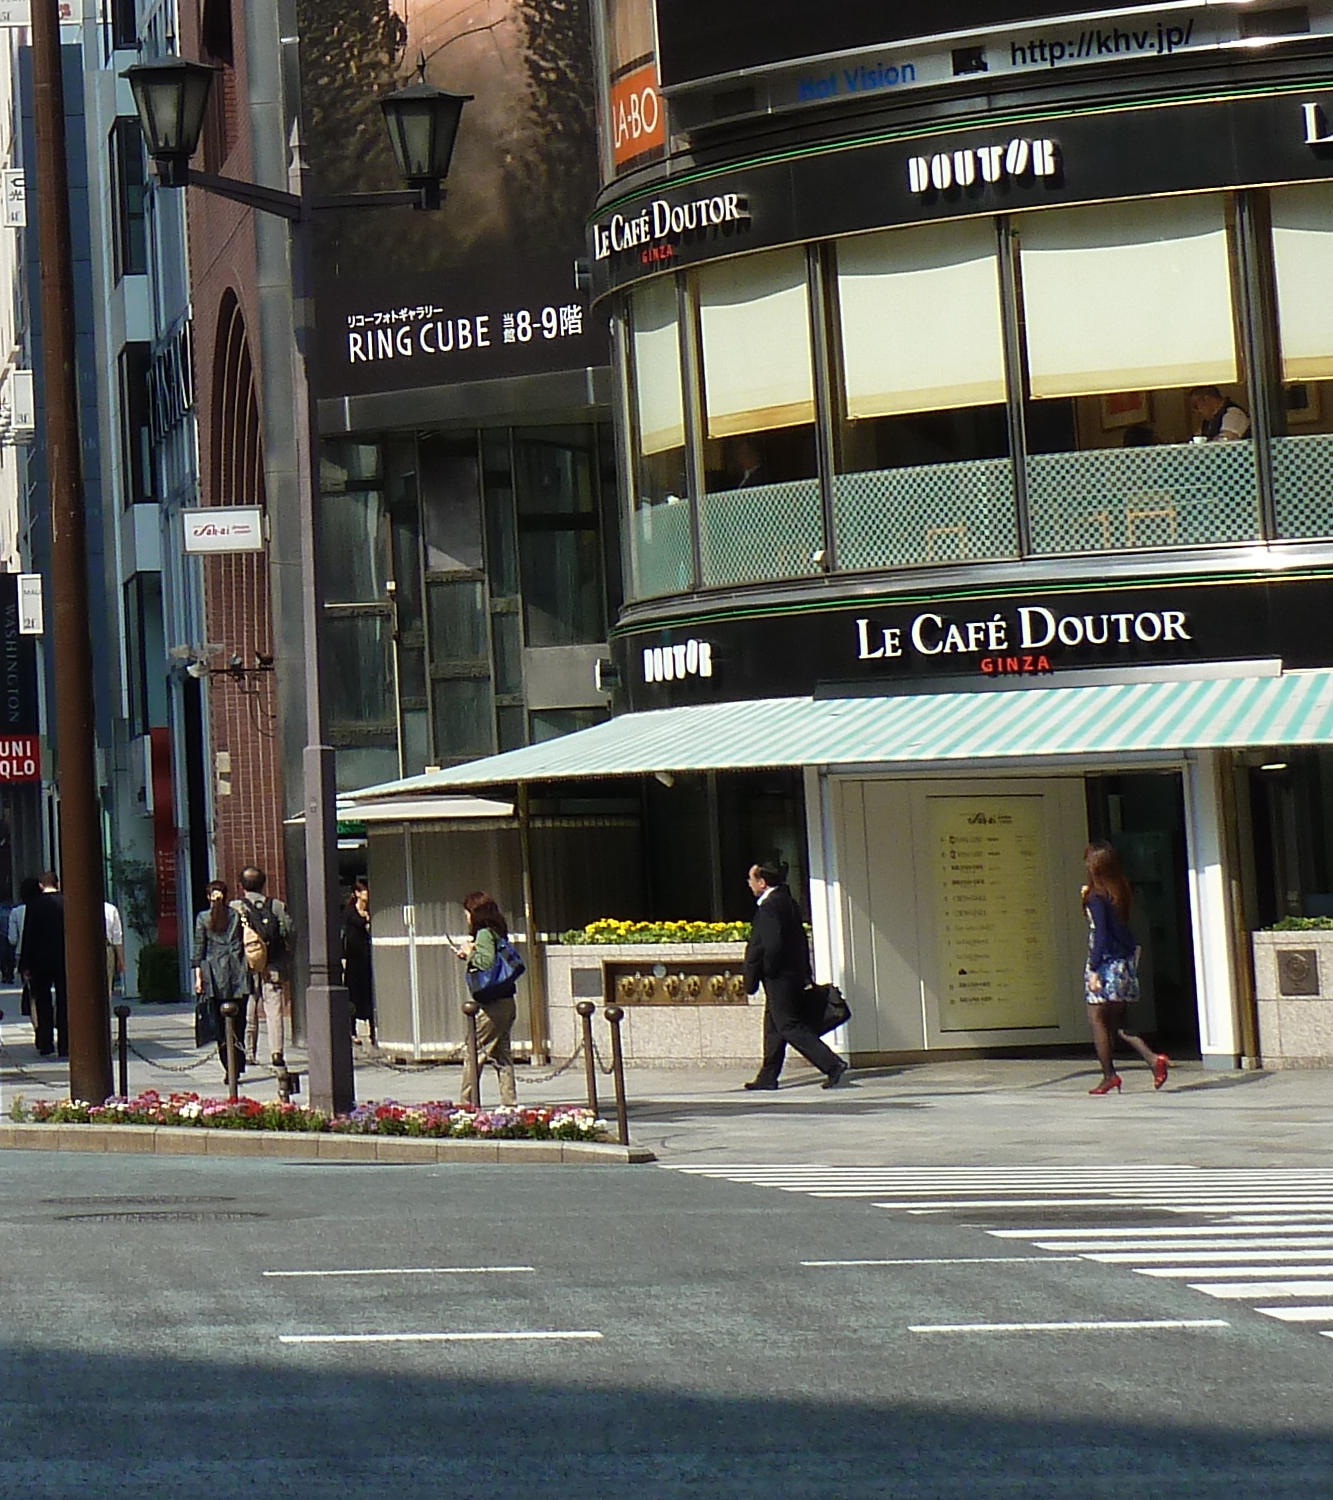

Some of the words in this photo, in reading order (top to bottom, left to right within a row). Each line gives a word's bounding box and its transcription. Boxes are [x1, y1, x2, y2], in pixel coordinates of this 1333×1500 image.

[1010, 18, 1195, 69] http://khv.jp/
[843, 60, 916, 92] Vision
[907, 137, 1056, 193] DOUTOR
[610, 203, 652, 252] CAFÉ
[652, 192, 740, 236] DOUTOR
[641, 243, 675, 264] GINZA
[348, 305, 443, 329] リコーフォトギャラリー
[349, 325, 412, 363] RING
[419, 315, 491, 354] CUBE
[856, 617, 902, 661] LE
[910, 612, 1009, 655] CAFÉ
[1018, 606, 1193, 650] DOUTOR
[4, 602, 20, 724] WASHINGTON
[979, 655, 1052, 674] GINZA
